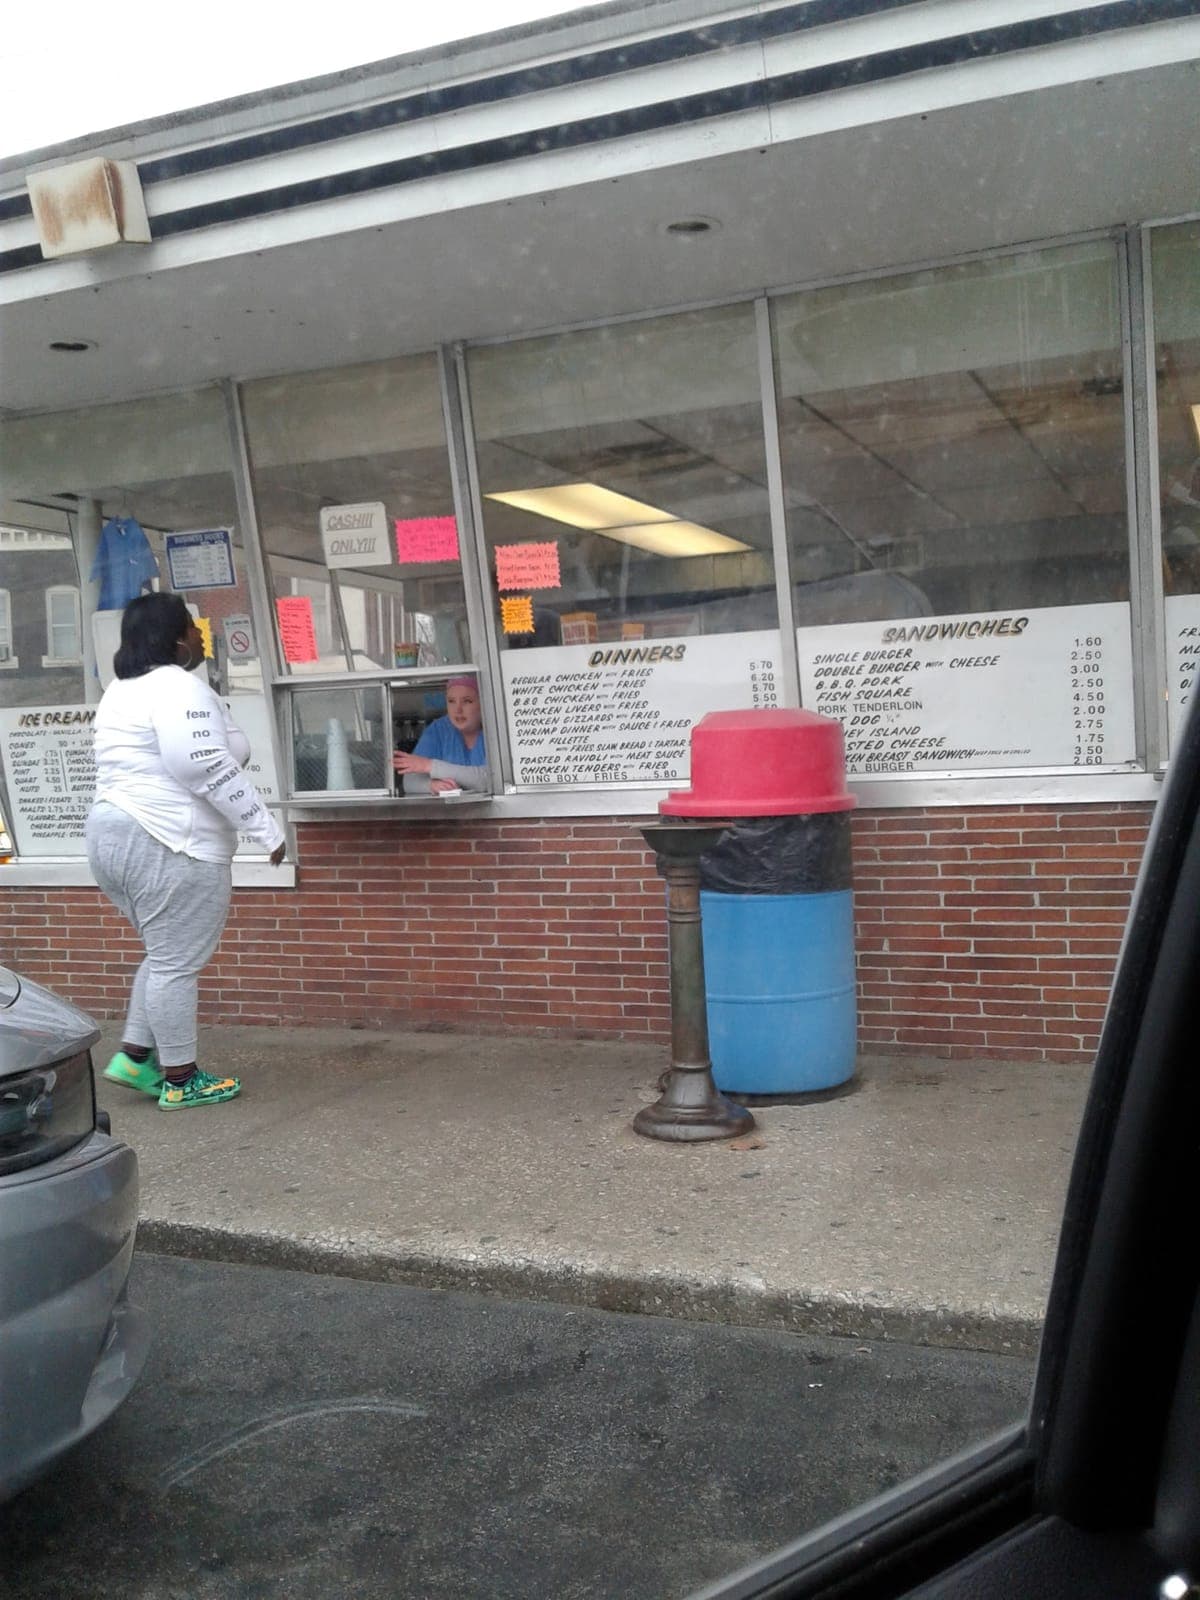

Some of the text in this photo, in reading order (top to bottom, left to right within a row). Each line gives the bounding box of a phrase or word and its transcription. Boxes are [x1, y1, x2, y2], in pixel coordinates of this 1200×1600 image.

[881, 617, 1029, 644] SANDWICHES
[588, 644, 686, 667] DINNERS
[812, 637, 1102, 665] SINGLE BURGER 1.60
[511, 675, 551, 685] REGULAR
[555, 671, 602, 682] CHICKEN
[620, 668, 653, 677] FRIES
[749, 660, 773, 671] 5.70
[814, 664, 865, 678] DOUBLE
[868, 661, 920, 674] BURGER
[949, 655, 1000, 669] CHEESE
[1071, 651, 1102, 660] 2.50
[512, 685, 544, 695] WHITE
[549, 682, 600, 694] CHICKEN
[616, 679, 646, 688] FRIES
[751, 672, 774, 681] 6.20
[860, 676, 904, 687] PORK
[1070, 664, 1099, 674] 3.00
[544, 693, 594, 705] CHICKEN
[612, 690, 640, 700] FRIES
[752, 682, 775, 692] 5.70
[815, 678, 1104, 701] FISH SQUARE 2.50
[514, 706, 562, 717] CHICKEN
[565, 703, 602, 713] LIVERS
[618, 700, 648, 710] FRIES
[752, 693, 777, 703] 5.50
[817, 692, 1104, 714] PORK TENDERLOIN 4.50
[19, 712, 41, 727] ICE
[186, 710, 211, 719] fear
[515, 716, 560, 727] CHICKEN
[563, 713, 613, 724] GIZZARDS
[630, 710, 660, 719] FRIES
[850, 714, 881, 725] DOG
[1073, 705, 1105, 715] 2.00
[192, 729, 210, 738] no
[516, 727, 558, 737] SHRIMP
[560, 724, 600, 735] DINNER
[618, 721, 651, 731] SAUCE
[660, 719, 691, 728] FRIES
[869, 726, 921, 737] ISLAND
[1074, 719, 1103, 729] 2.75
[518, 735, 590, 746] FISH FILLETTE
[596, 743, 618, 751] SLAW
[619, 741, 646, 750] BREAD
[654, 739, 687, 748] TARTAR
[890, 737, 947, 749] CHEESE
[1076, 733, 1104, 743] 1.75
[520, 756, 560, 764] TOASTED
[564, 754, 608, 762] RAVIOLI
[626, 751, 652, 760] MEAT
[655, 749, 686, 759] SAUCE
[867, 751, 911, 763] BREAST
[912, 749, 976, 761] SANDWICH
[1074, 745, 1103, 755] 3.50
[520, 765, 569, 775] CHICKEN
[572, 763, 621, 773] TENDERS
[638, 761, 669, 770] FRIES
[865, 761, 914, 772] BURGER
[1073, 756, 1103, 766] 2.60
[207, 766, 240, 791] beast
[521, 774, 550, 784] WING
[557, 774, 578, 783] BOX
[594, 771, 628, 781] FRIES
[229, 789, 245, 802] no
[240, 803, 261, 821] evil
